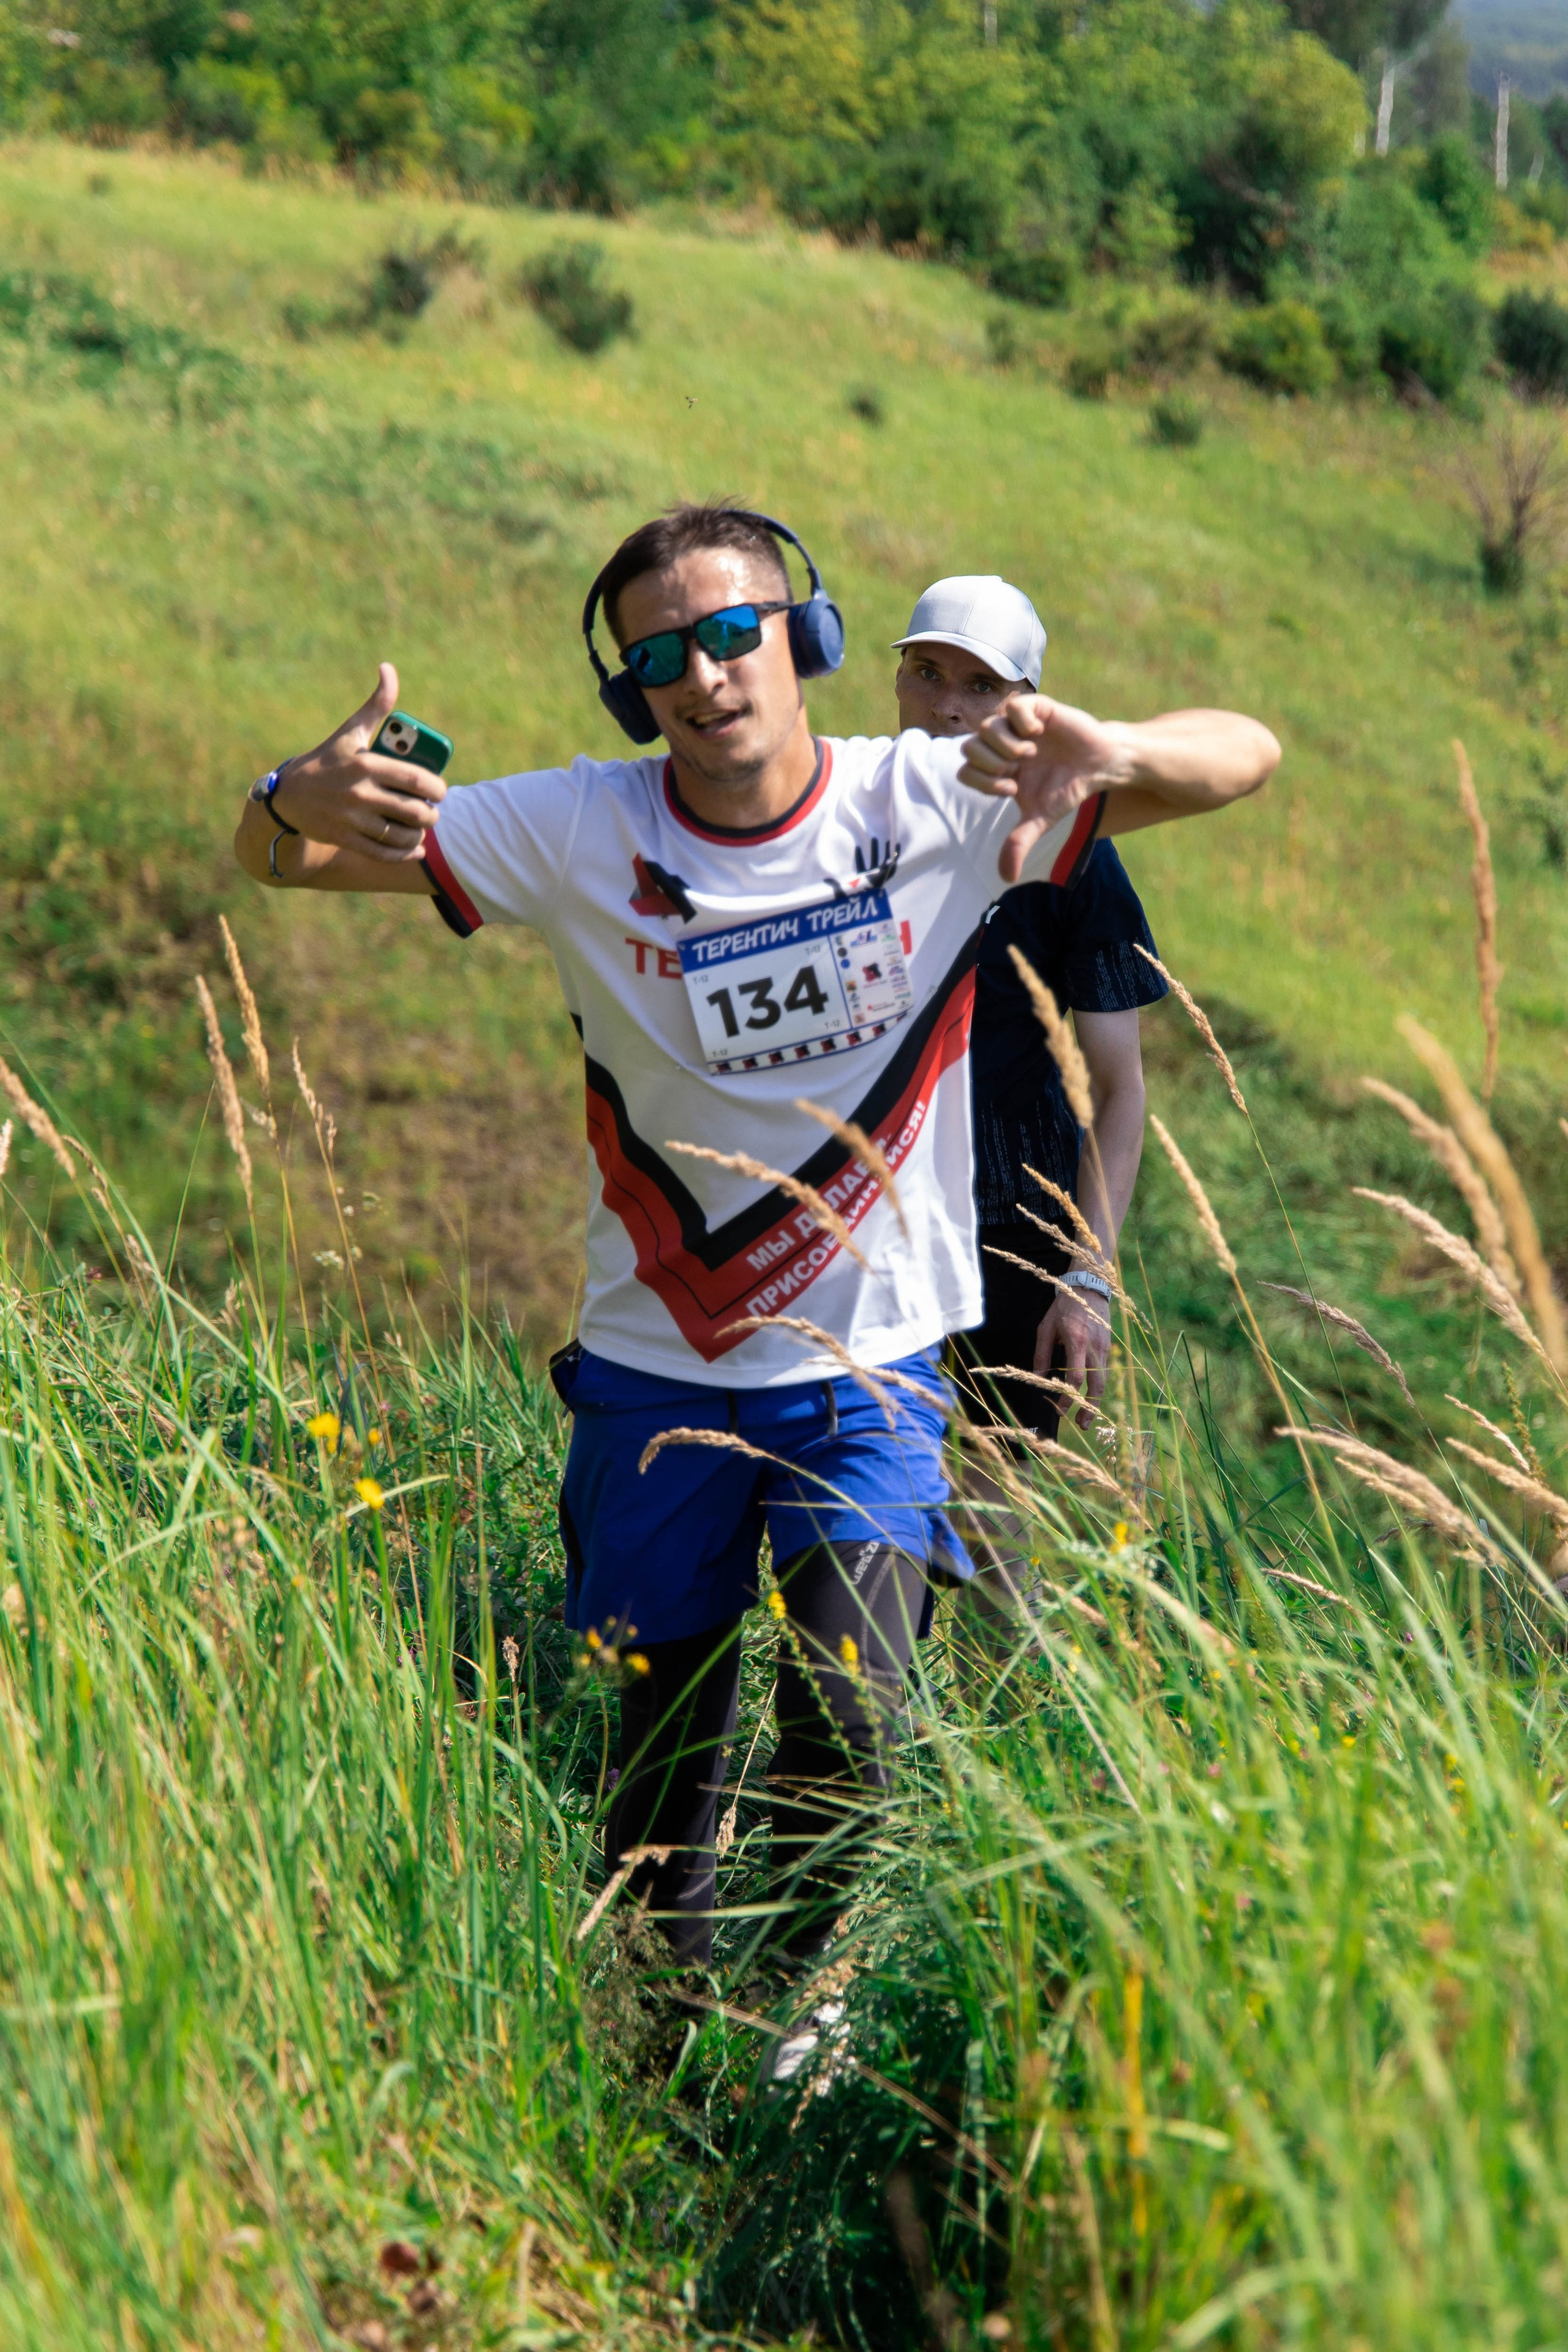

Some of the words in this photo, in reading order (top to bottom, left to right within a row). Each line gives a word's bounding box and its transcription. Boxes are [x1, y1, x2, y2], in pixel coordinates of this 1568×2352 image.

[692, 917, 799, 963] ТЕРЕНТИЧ
[806, 895, 878, 932] ТРЕЙЛ
[706, 965, 829, 1038] 134
[745, 1100, 926, 1317] ПРИСОЕИНЙСЯ!
[746, 1230, 796, 1272] МЫ
